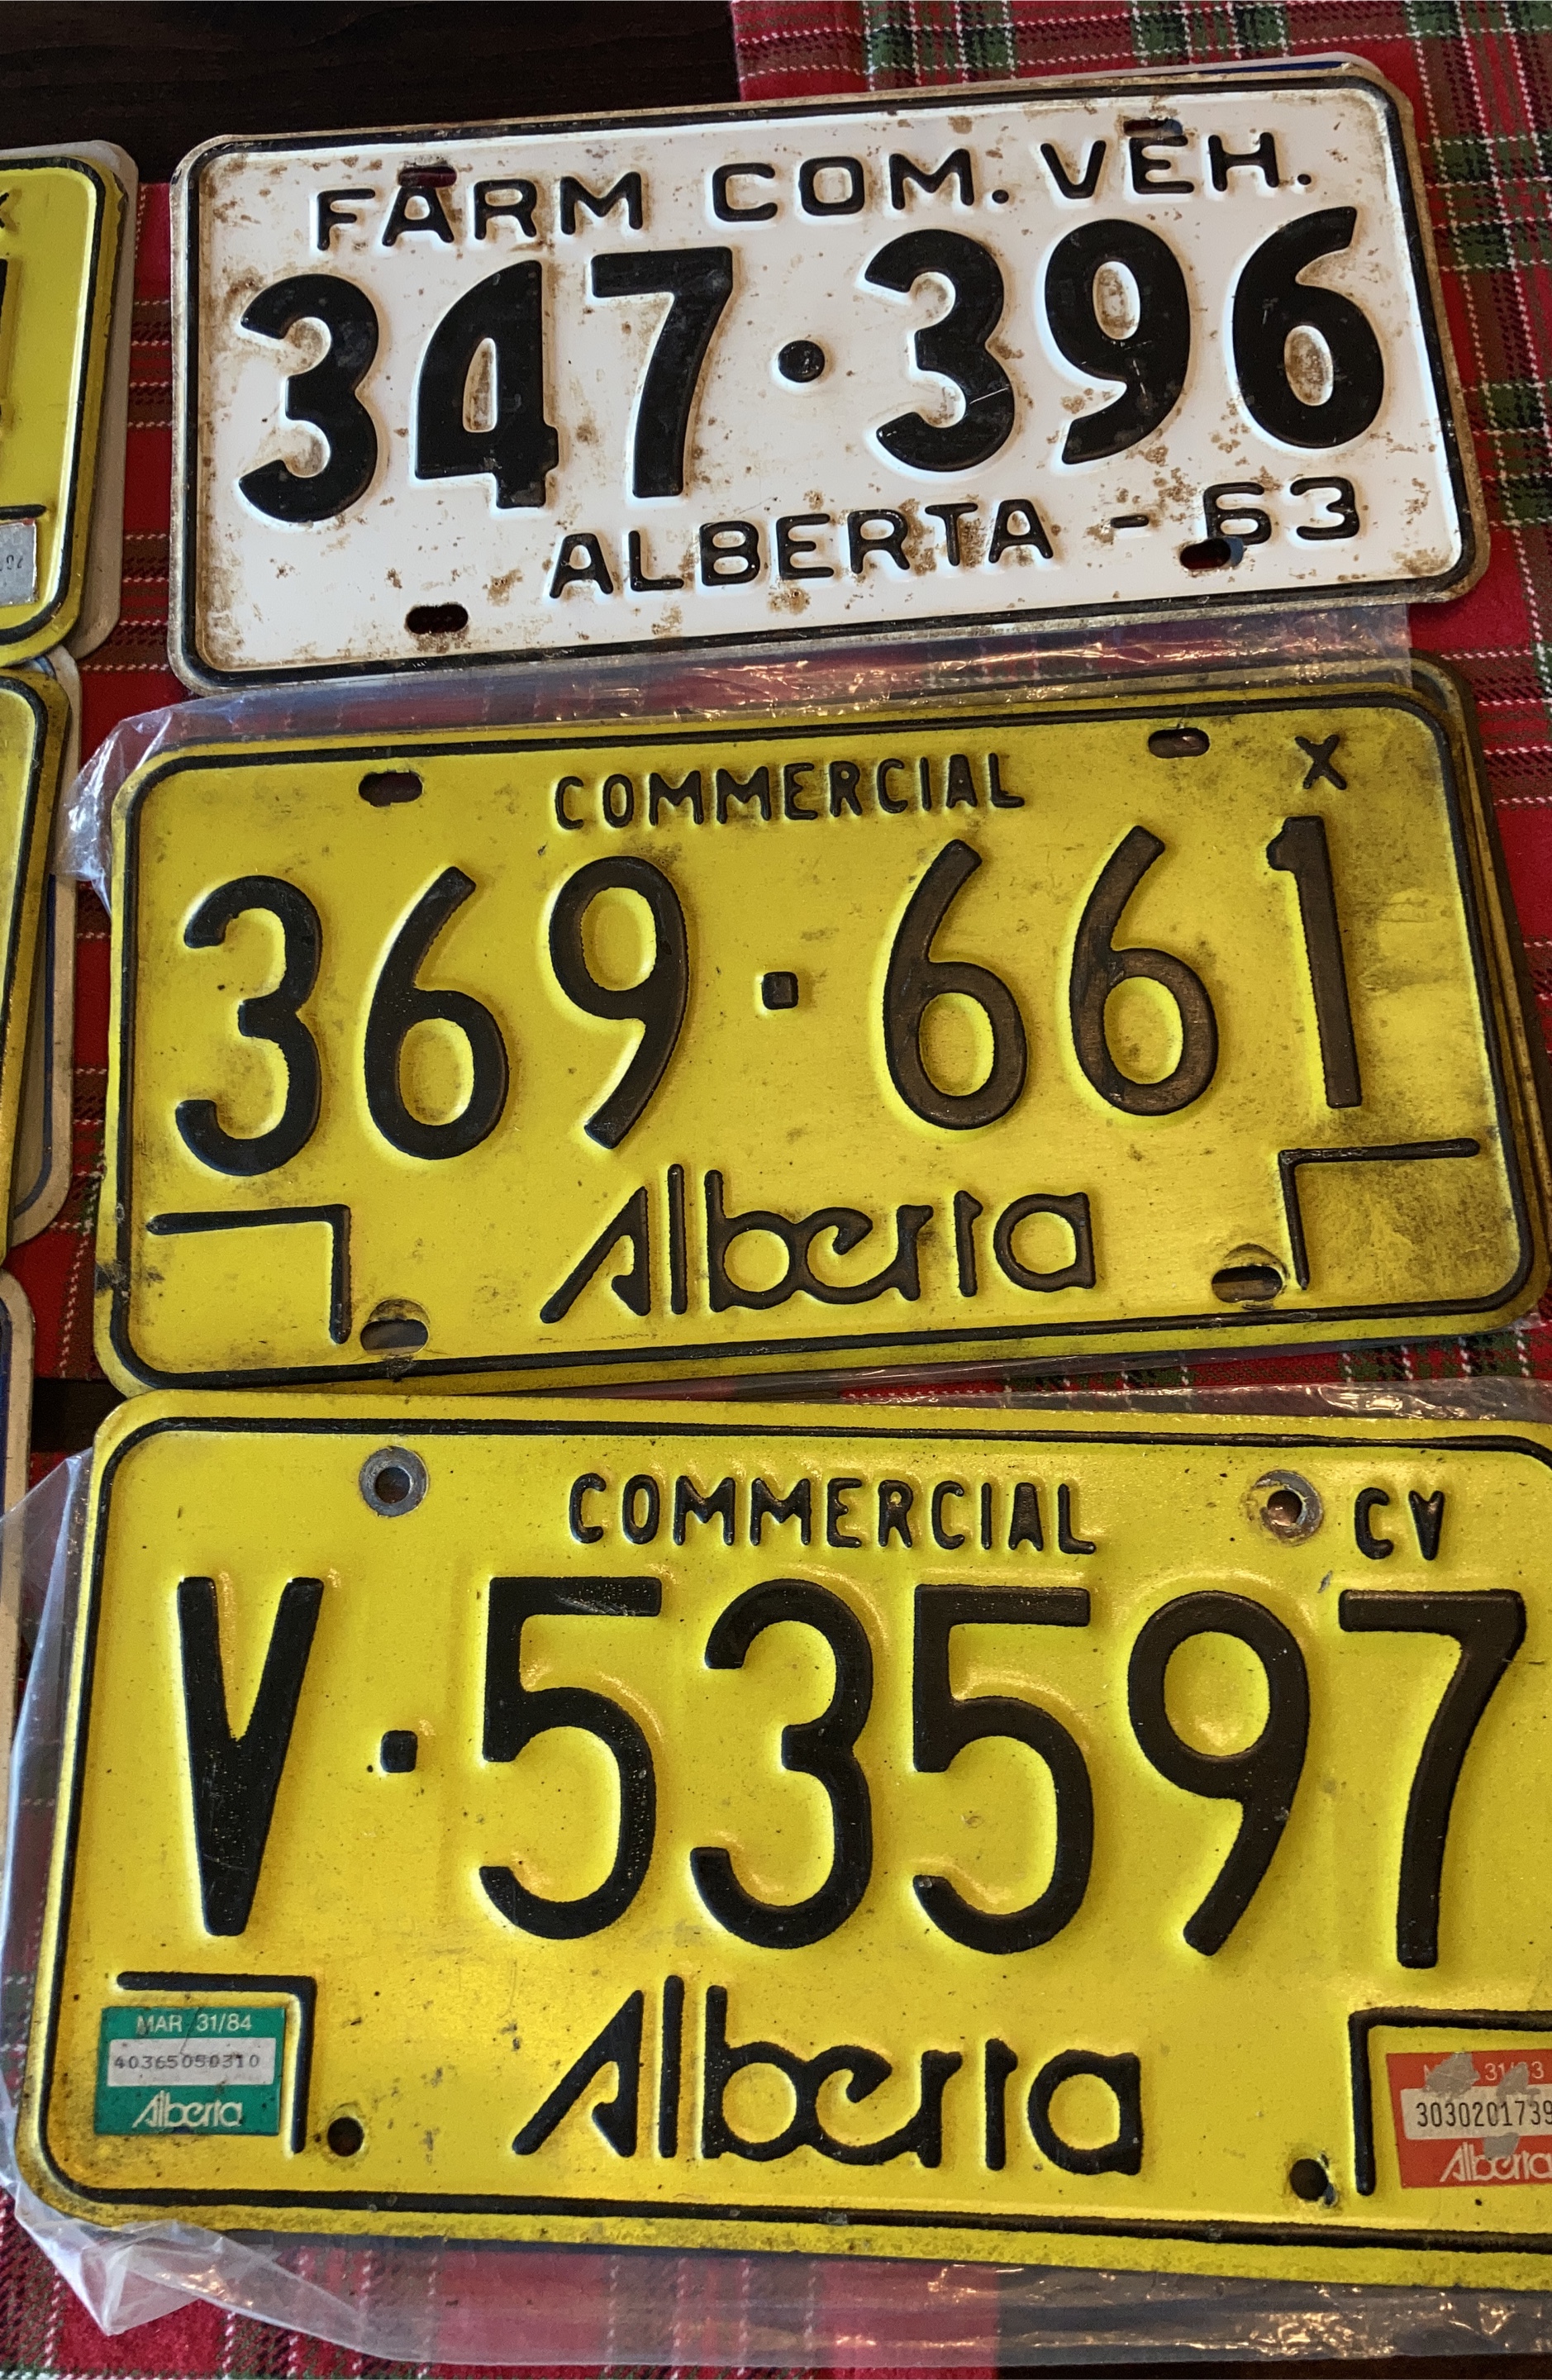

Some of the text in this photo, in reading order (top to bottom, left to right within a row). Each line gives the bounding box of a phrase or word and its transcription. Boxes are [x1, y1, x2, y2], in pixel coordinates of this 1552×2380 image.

[317, 132, 1312, 251] FARM COM. VEH.
[549, 500, 1054, 599] ALBERTA
[1202, 477, 1360, 545] 63
[555, 753, 1026, 829] COMMERCIAL
[1295, 735, 1347, 791] X
[540, 1164, 1096, 1324] Alberta
[570, 1473, 1097, 1554] COMMERCIAL
[1354, 1488, 1445, 1561] CV
[136, 2013, 253, 2034] MAR 31/84
[132, 2090, 242, 2129] Alberta
[512, 1976, 1144, 2175] Alberta
